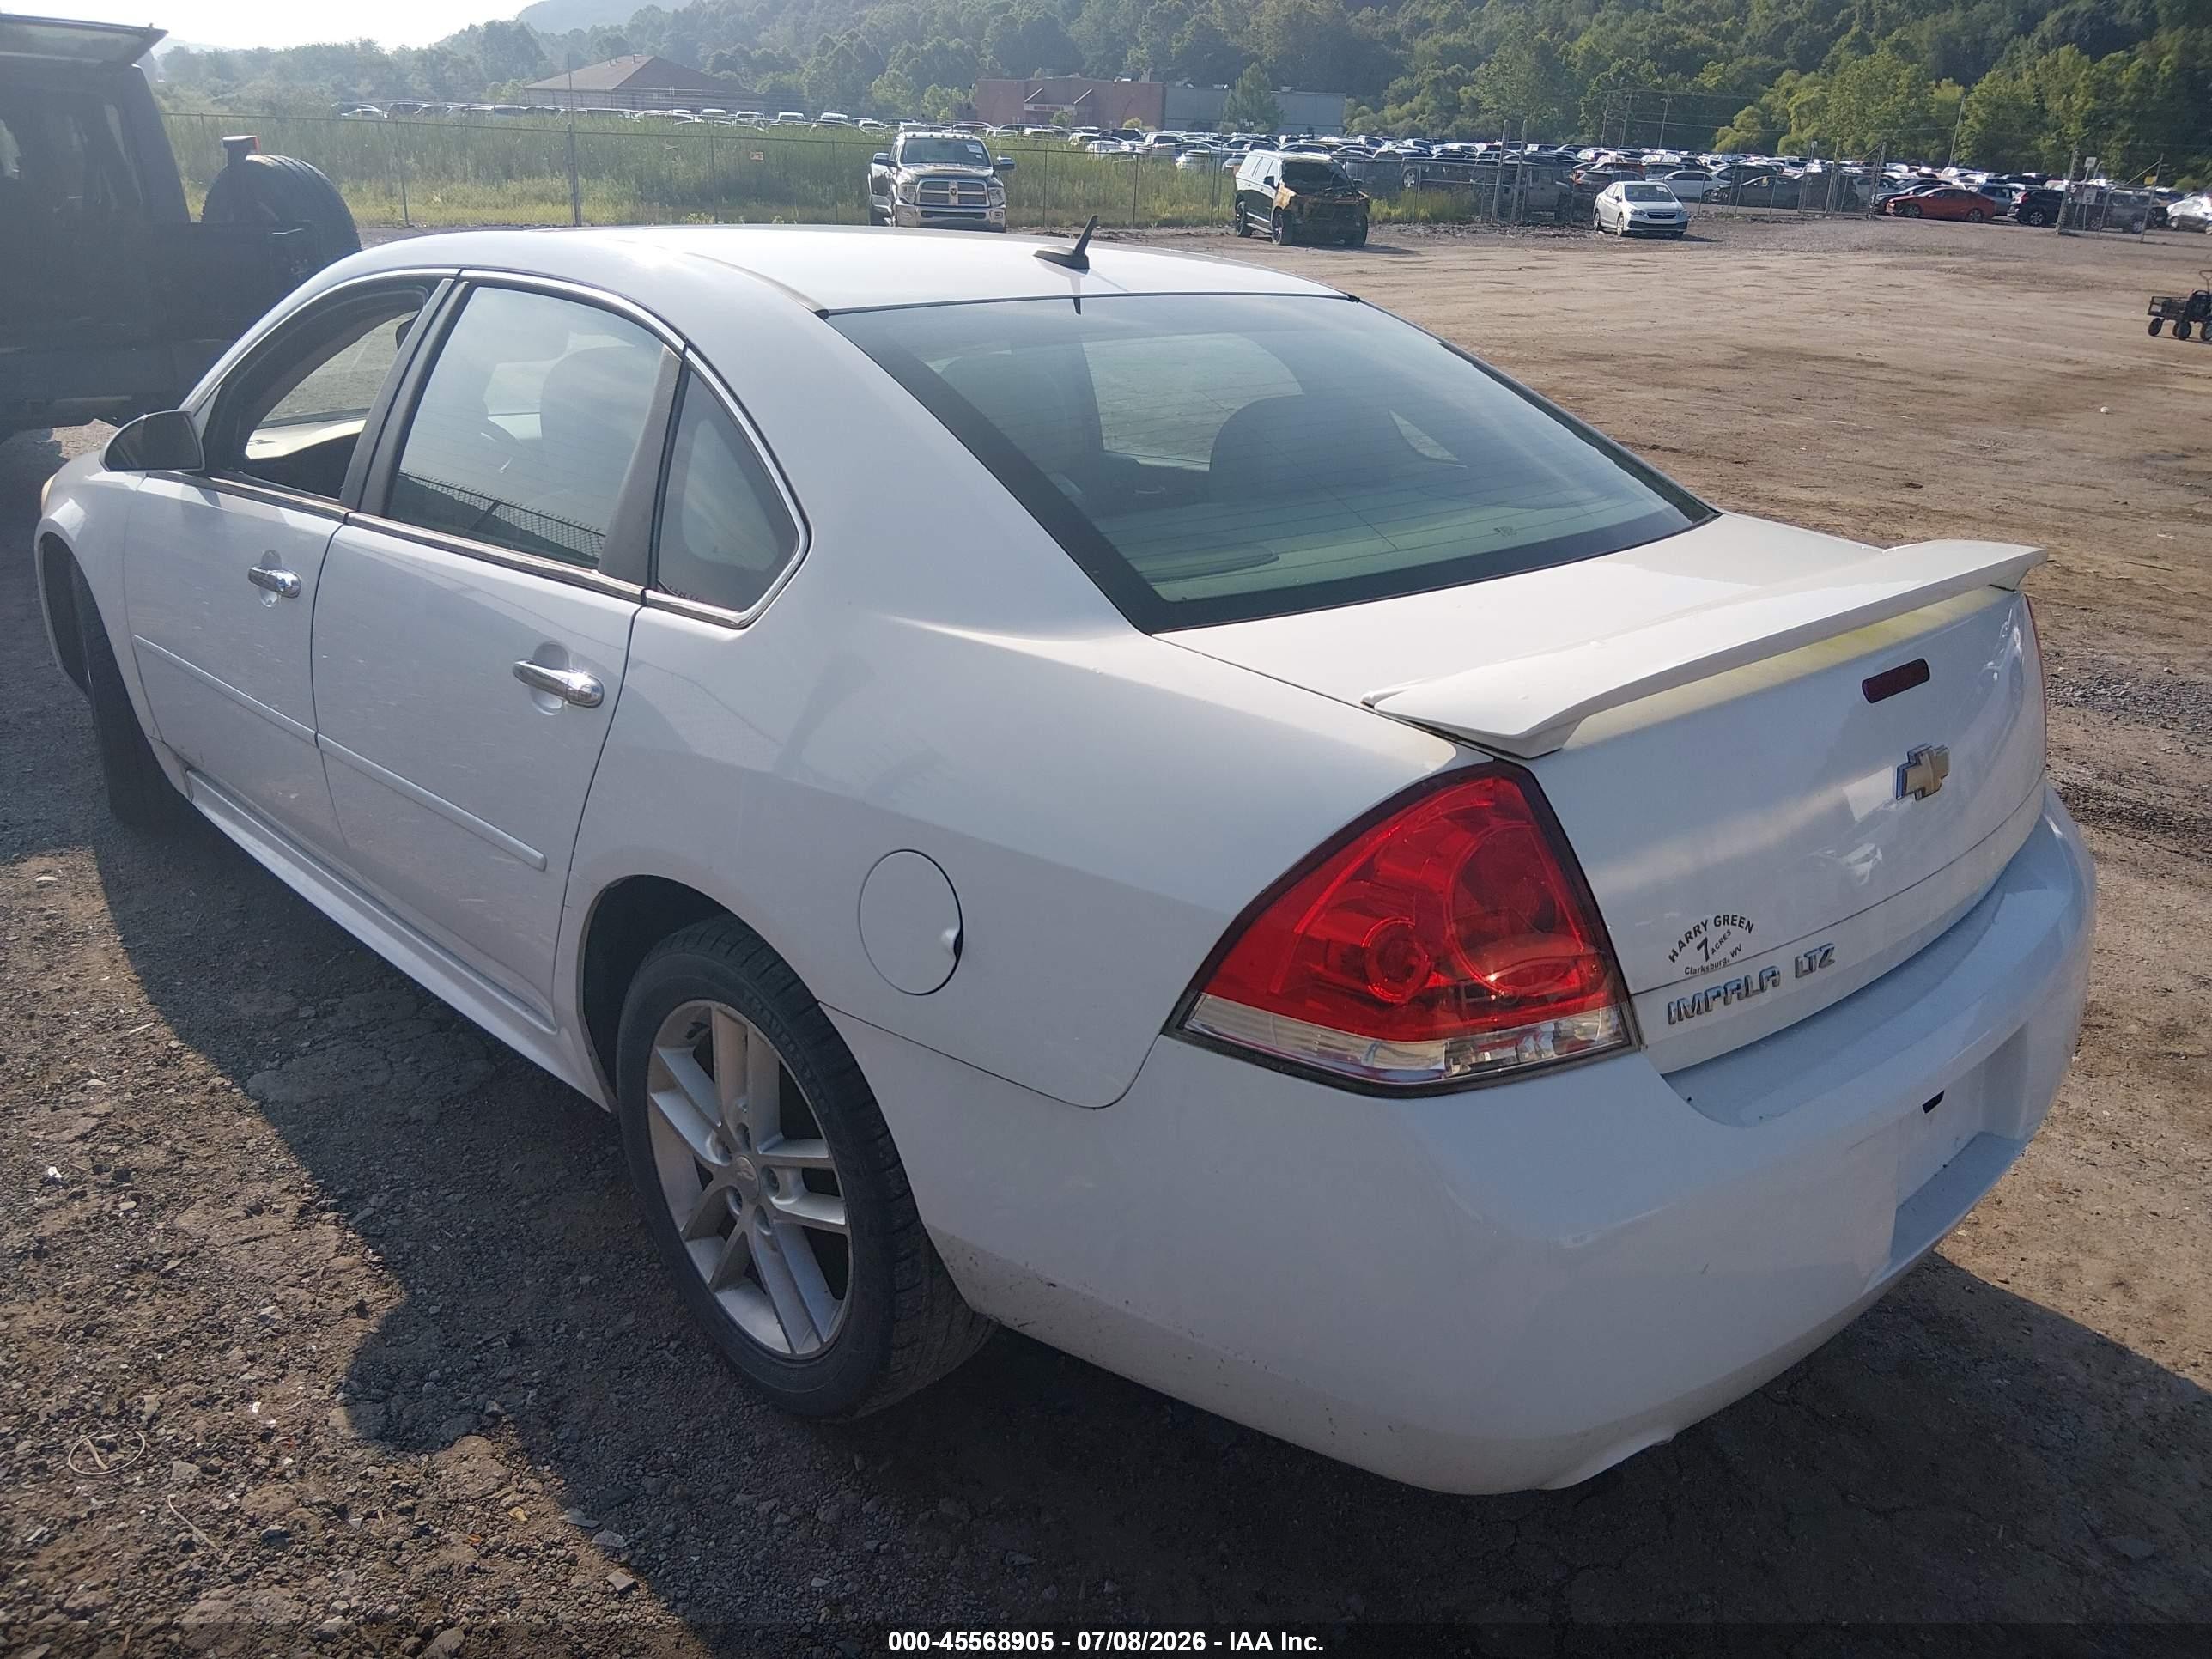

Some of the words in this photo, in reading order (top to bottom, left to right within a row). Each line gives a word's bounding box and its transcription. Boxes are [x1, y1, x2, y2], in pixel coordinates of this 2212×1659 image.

[1668, 919, 1709, 963] HARRY
[1713, 914, 1754, 934] GREEN
[1684, 957, 1730, 975] Clarksburg,
[1729, 943, 1743, 959] WV
[1696, 936, 1711, 963] 7
[1711, 929, 1732, 955] ACRES
[1668, 965, 1781, 1025] IMPALA
[1795, 942, 1836, 979] LTZ
